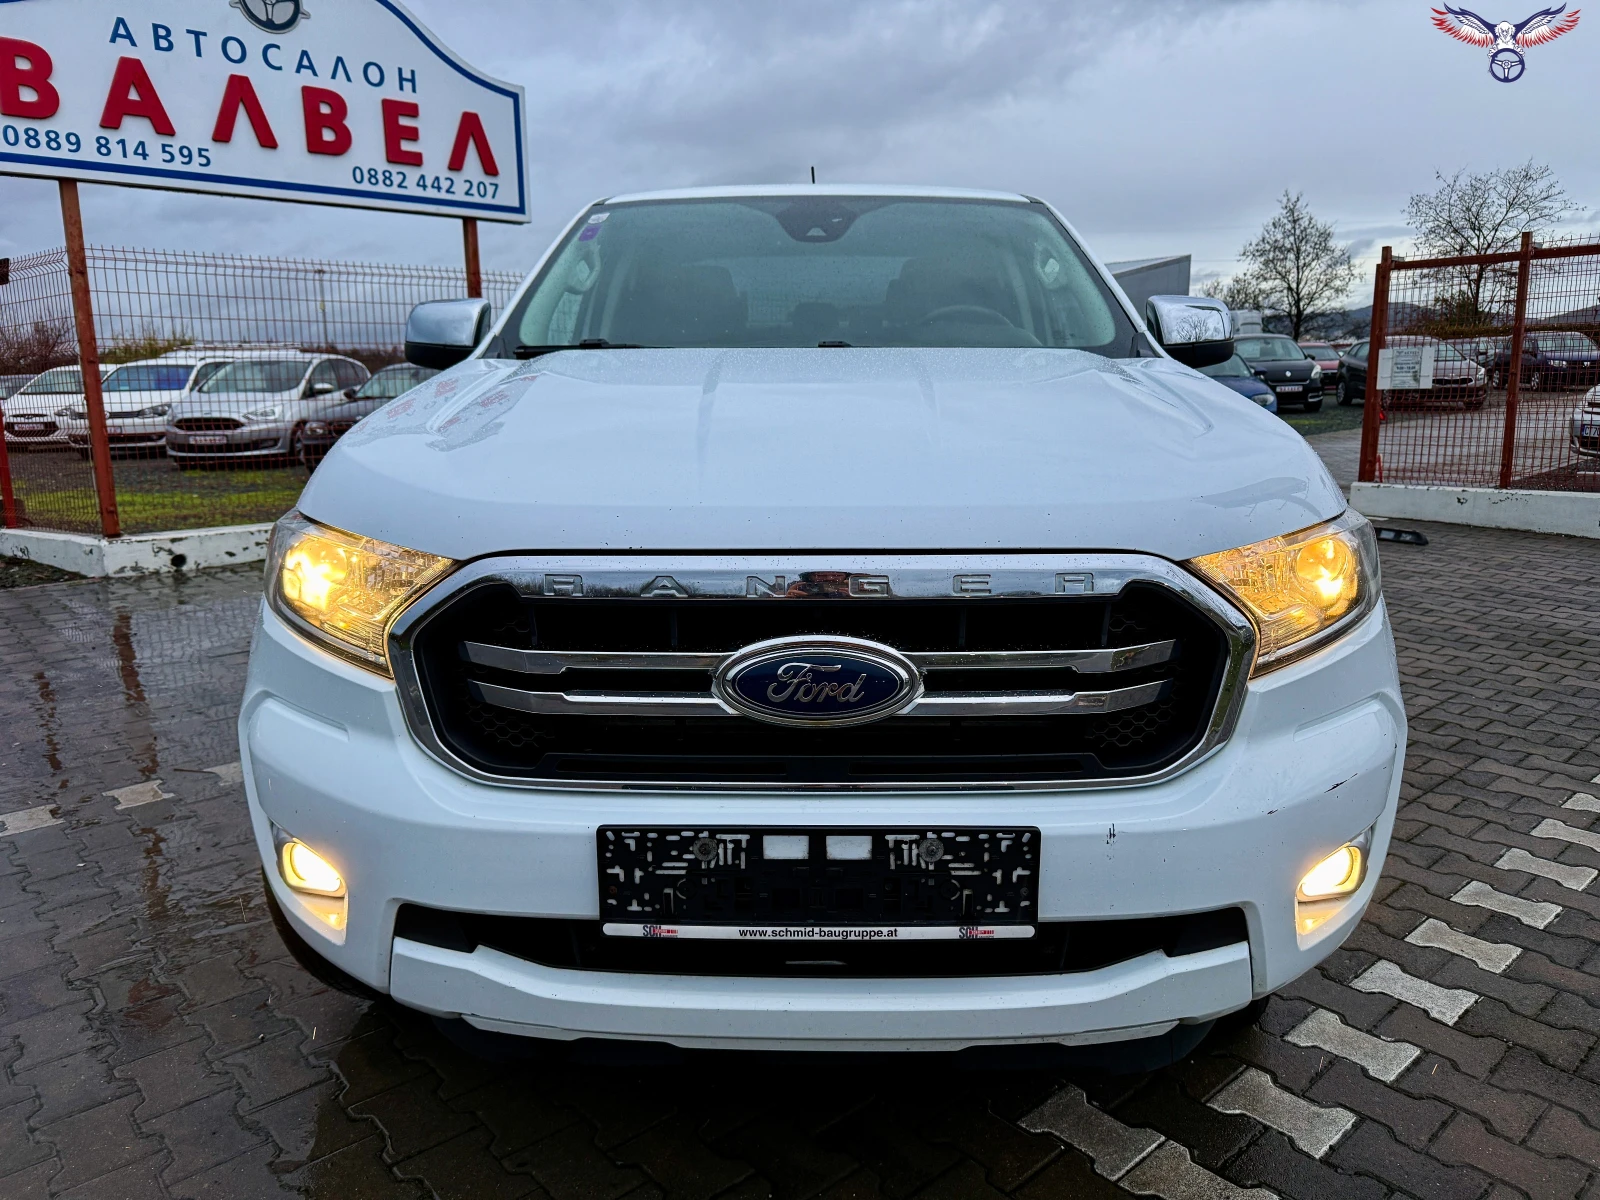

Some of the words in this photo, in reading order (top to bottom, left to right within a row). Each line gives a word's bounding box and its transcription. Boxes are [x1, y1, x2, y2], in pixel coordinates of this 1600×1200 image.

[108, 16, 418, 94] АВТОСАЛОН
[0, 36, 499, 176] ВАЛВЕЛ
[2, 124, 82, 153] 0889
[95, 135, 150, 161] 814
[161, 143, 212, 167] 595
[352, 166, 408, 189] 0882
[416, 174, 456, 195] 442
[463, 179, 499, 199] 207
[543, 573, 1095, 598] RANGER
[766, 662, 867, 703] Ford
[738, 927, 898, 940] www.schmid-baugruppe.at
